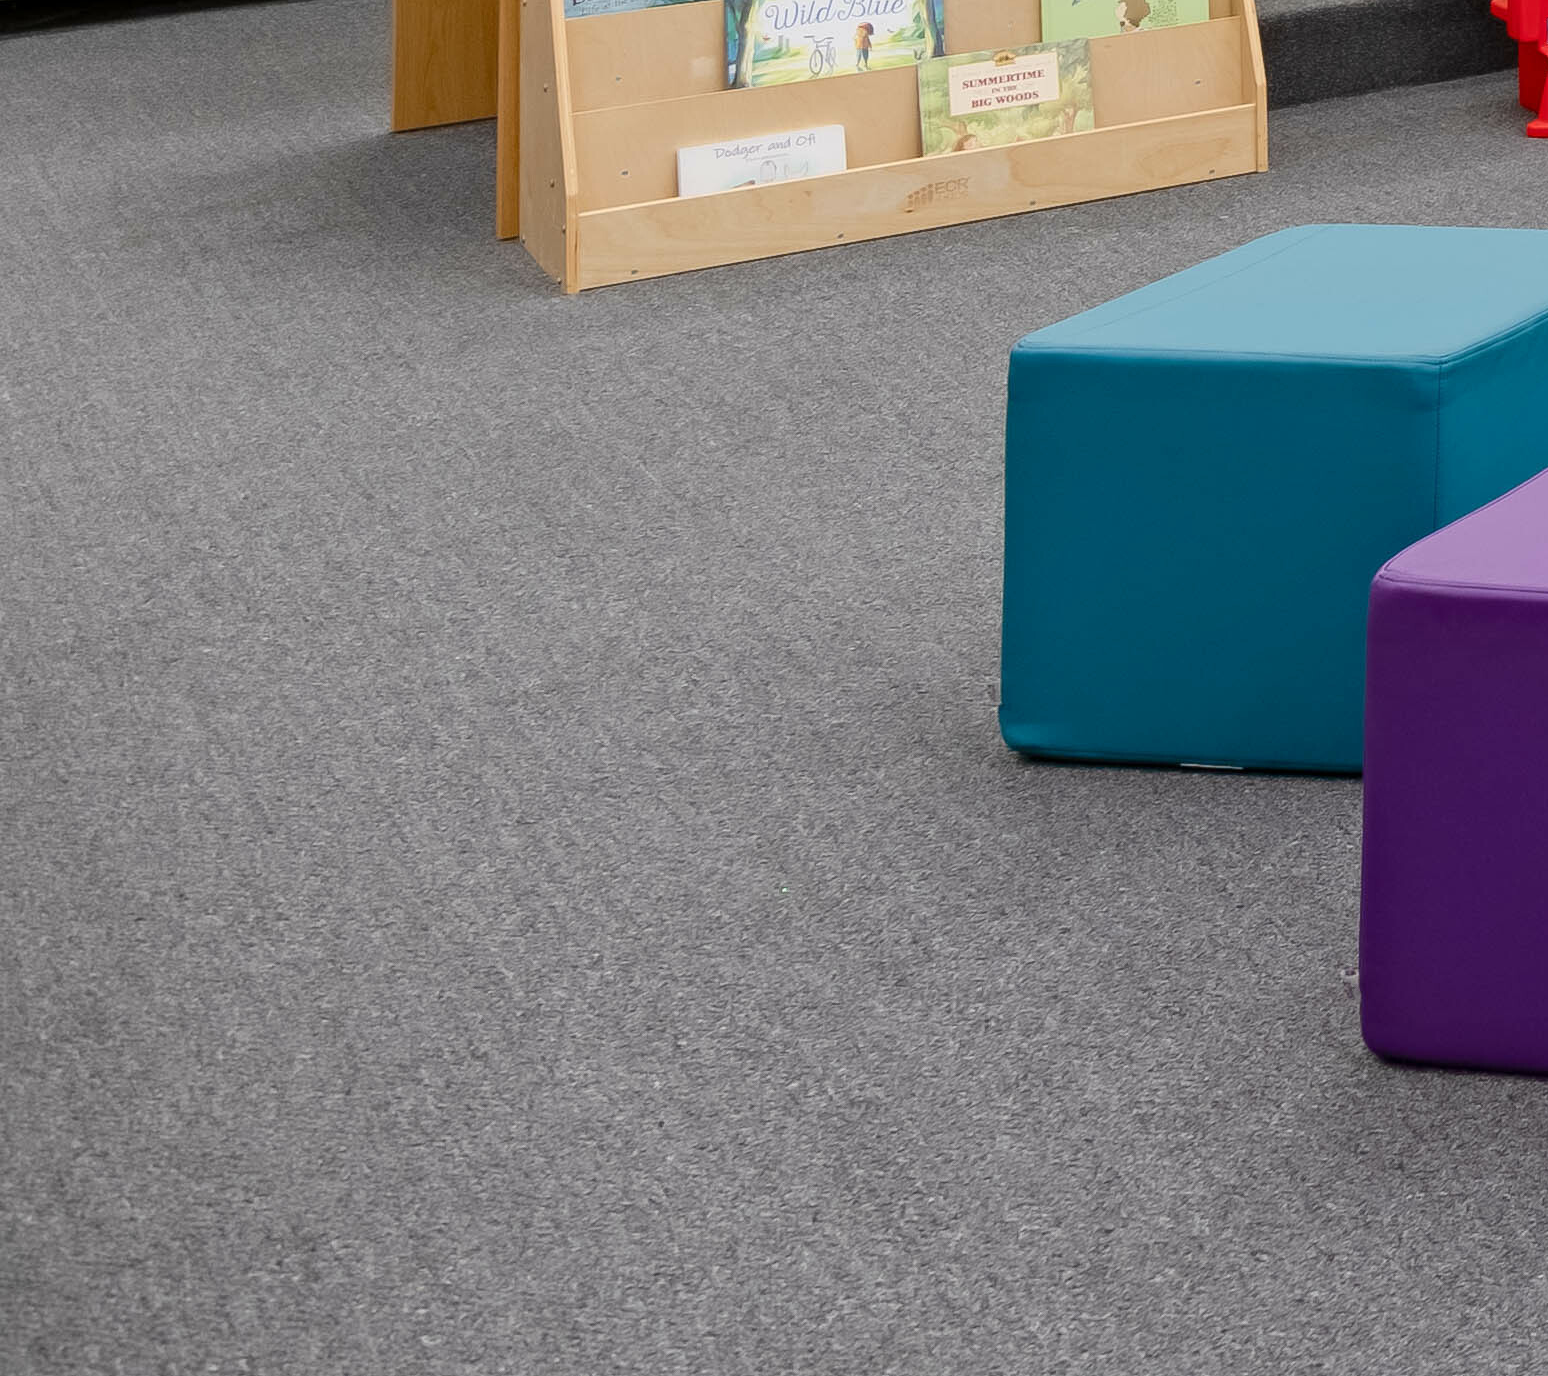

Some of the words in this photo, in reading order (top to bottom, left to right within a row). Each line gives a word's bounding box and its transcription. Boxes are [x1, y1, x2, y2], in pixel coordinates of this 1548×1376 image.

[765, 0, 837, 31] Wild
[961, 68, 1046, 89] SUMMERTIME
[971, 96, 992, 108] BIG
[995, 90, 1040, 105] WOODS
[768, 137, 793, 151] and
